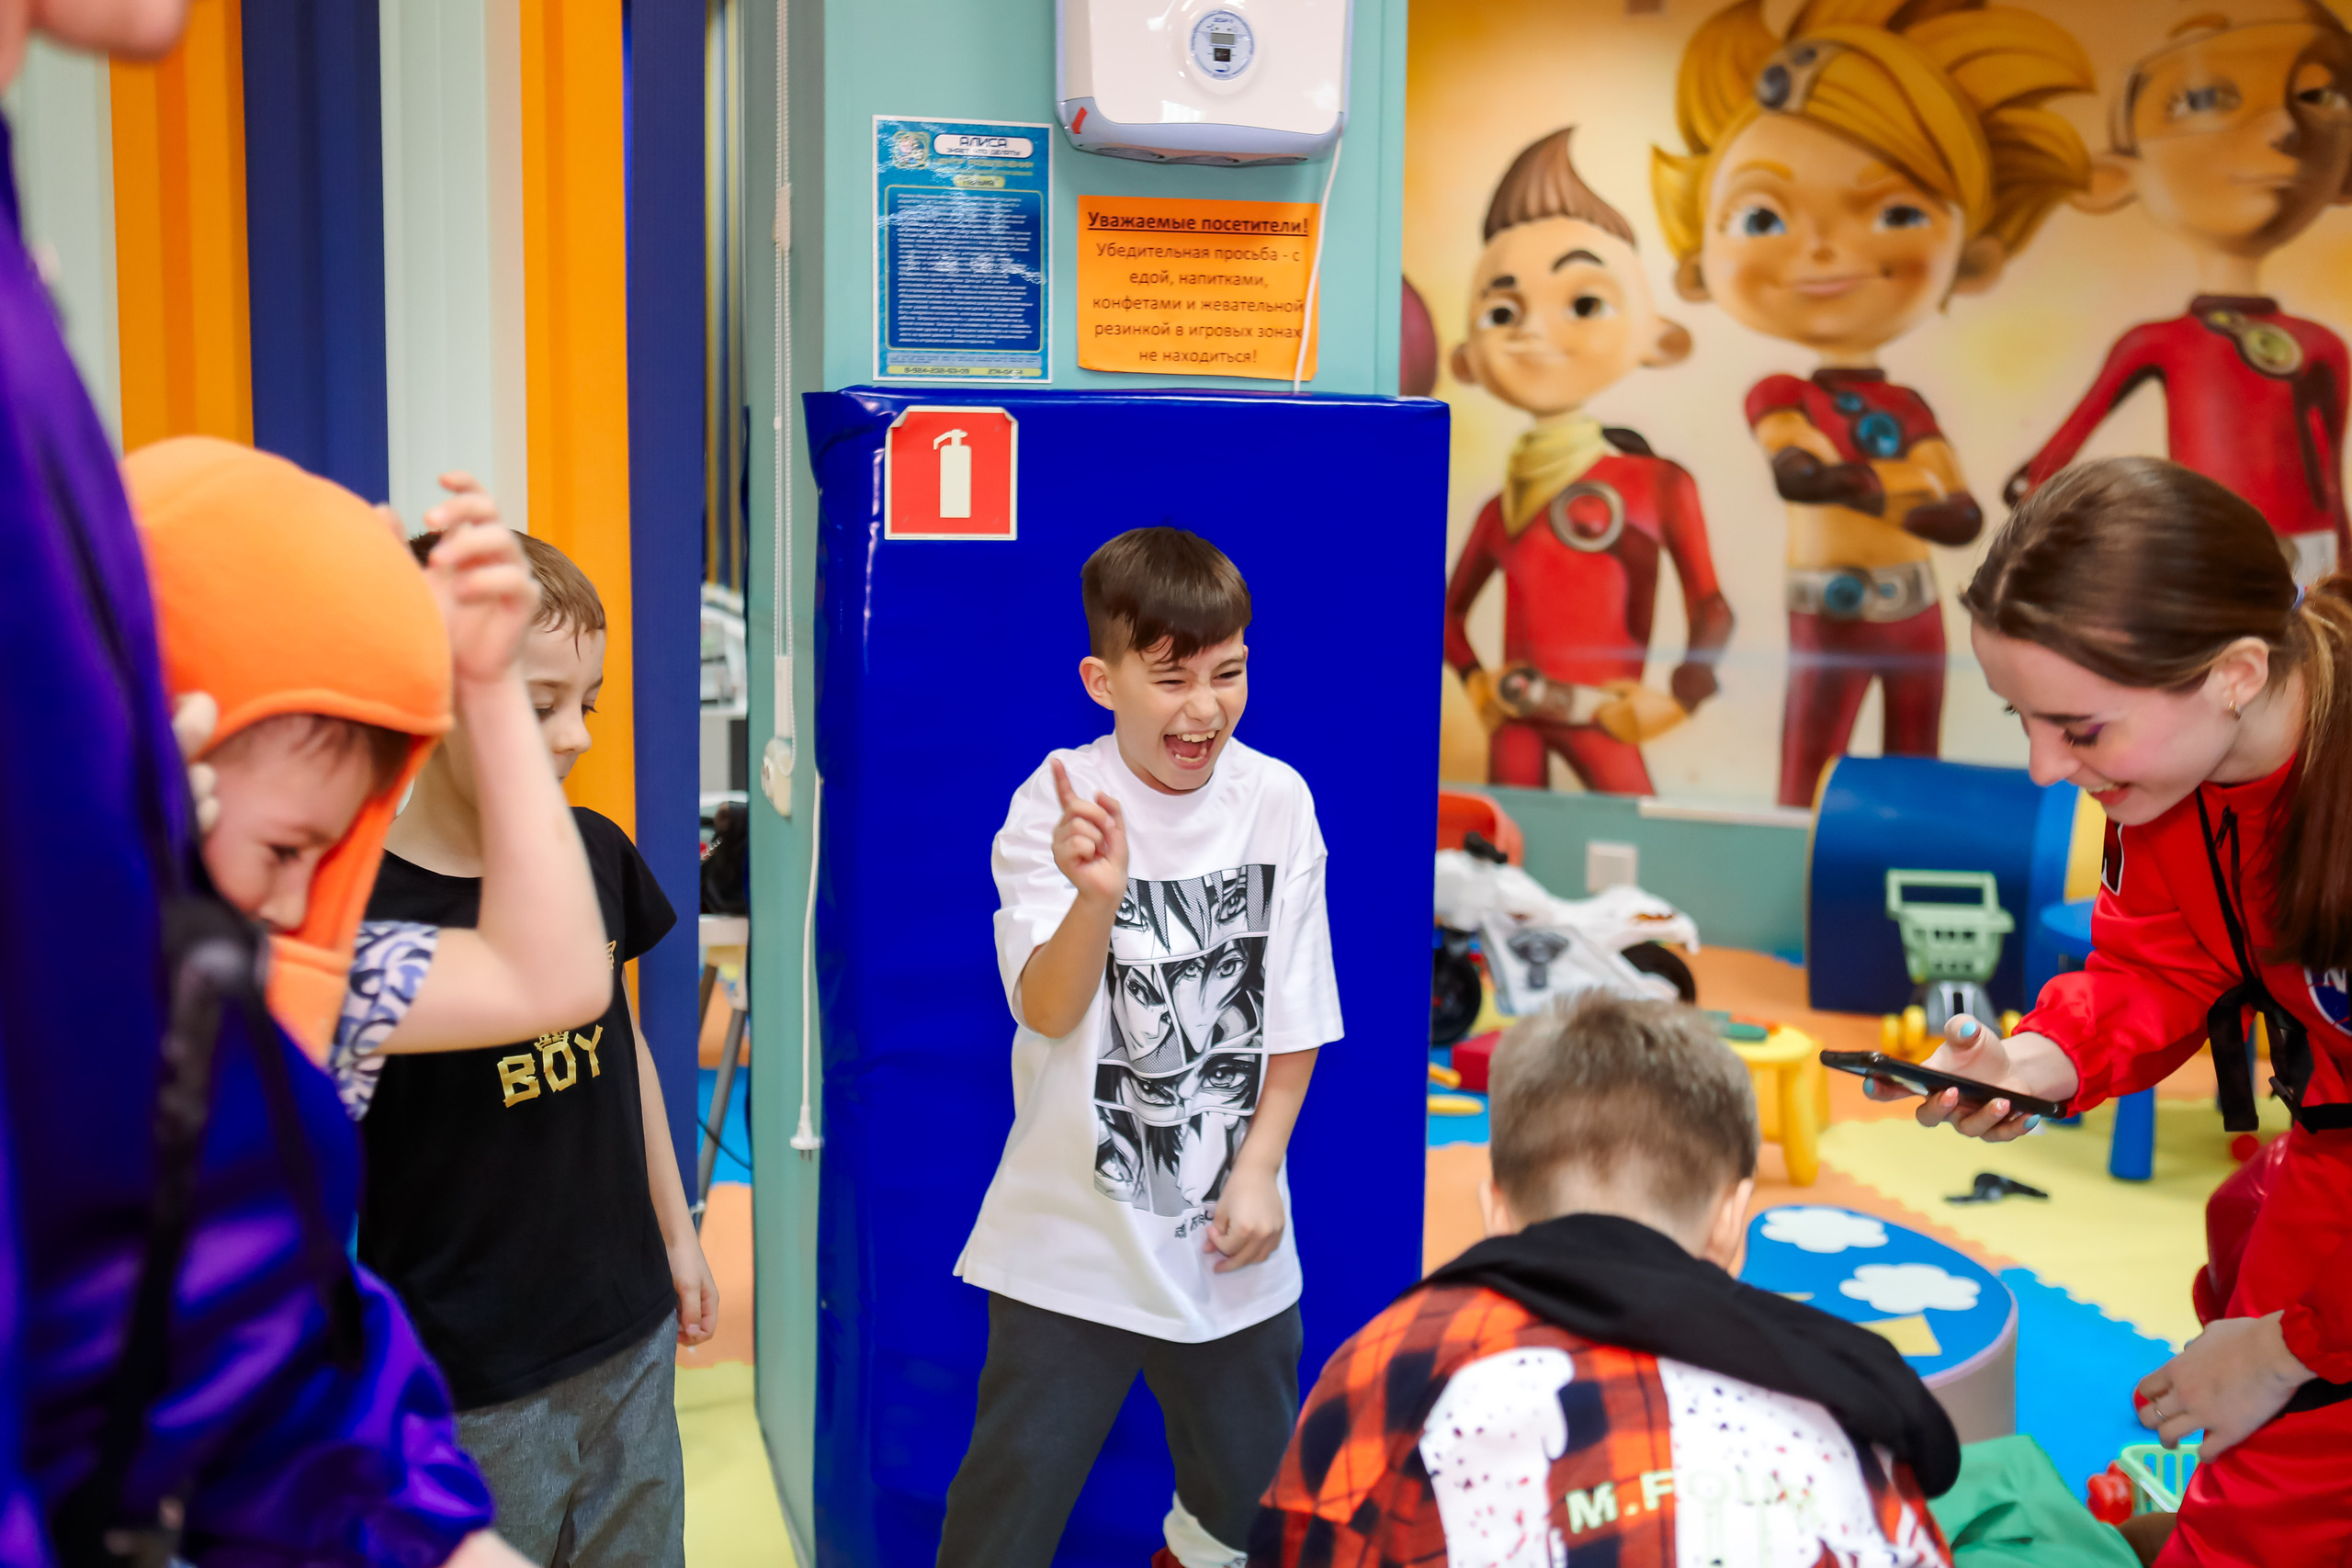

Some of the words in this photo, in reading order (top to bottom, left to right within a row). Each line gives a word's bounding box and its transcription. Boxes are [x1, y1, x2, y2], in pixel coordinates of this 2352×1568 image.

[1087, 211, 1196, 230] Уважаемые
[1202, 218, 1309, 233] посетители!
[1096, 243, 1210, 259] Убедительная
[1215, 246, 1278, 263] просьба
[1292, 250, 1301, 262] с
[1129, 269, 1174, 287] едой,
[1179, 275, 1269, 288] напитками,
[1092, 296, 1182, 312] конфетами
[1186, 300, 1196, 310] и
[1200, 299, 1305, 313] жевательной
[1094, 322, 1170, 338] резинкой
[1175, 326, 1184, 336] в
[1189, 326, 1252, 340] игровых
[1257, 328, 1303, 339] зонах
[1139, 351, 1158, 362] не
[1162, 349, 1258, 364] находиться!
[497, 1024, 604, 1109] BOY
